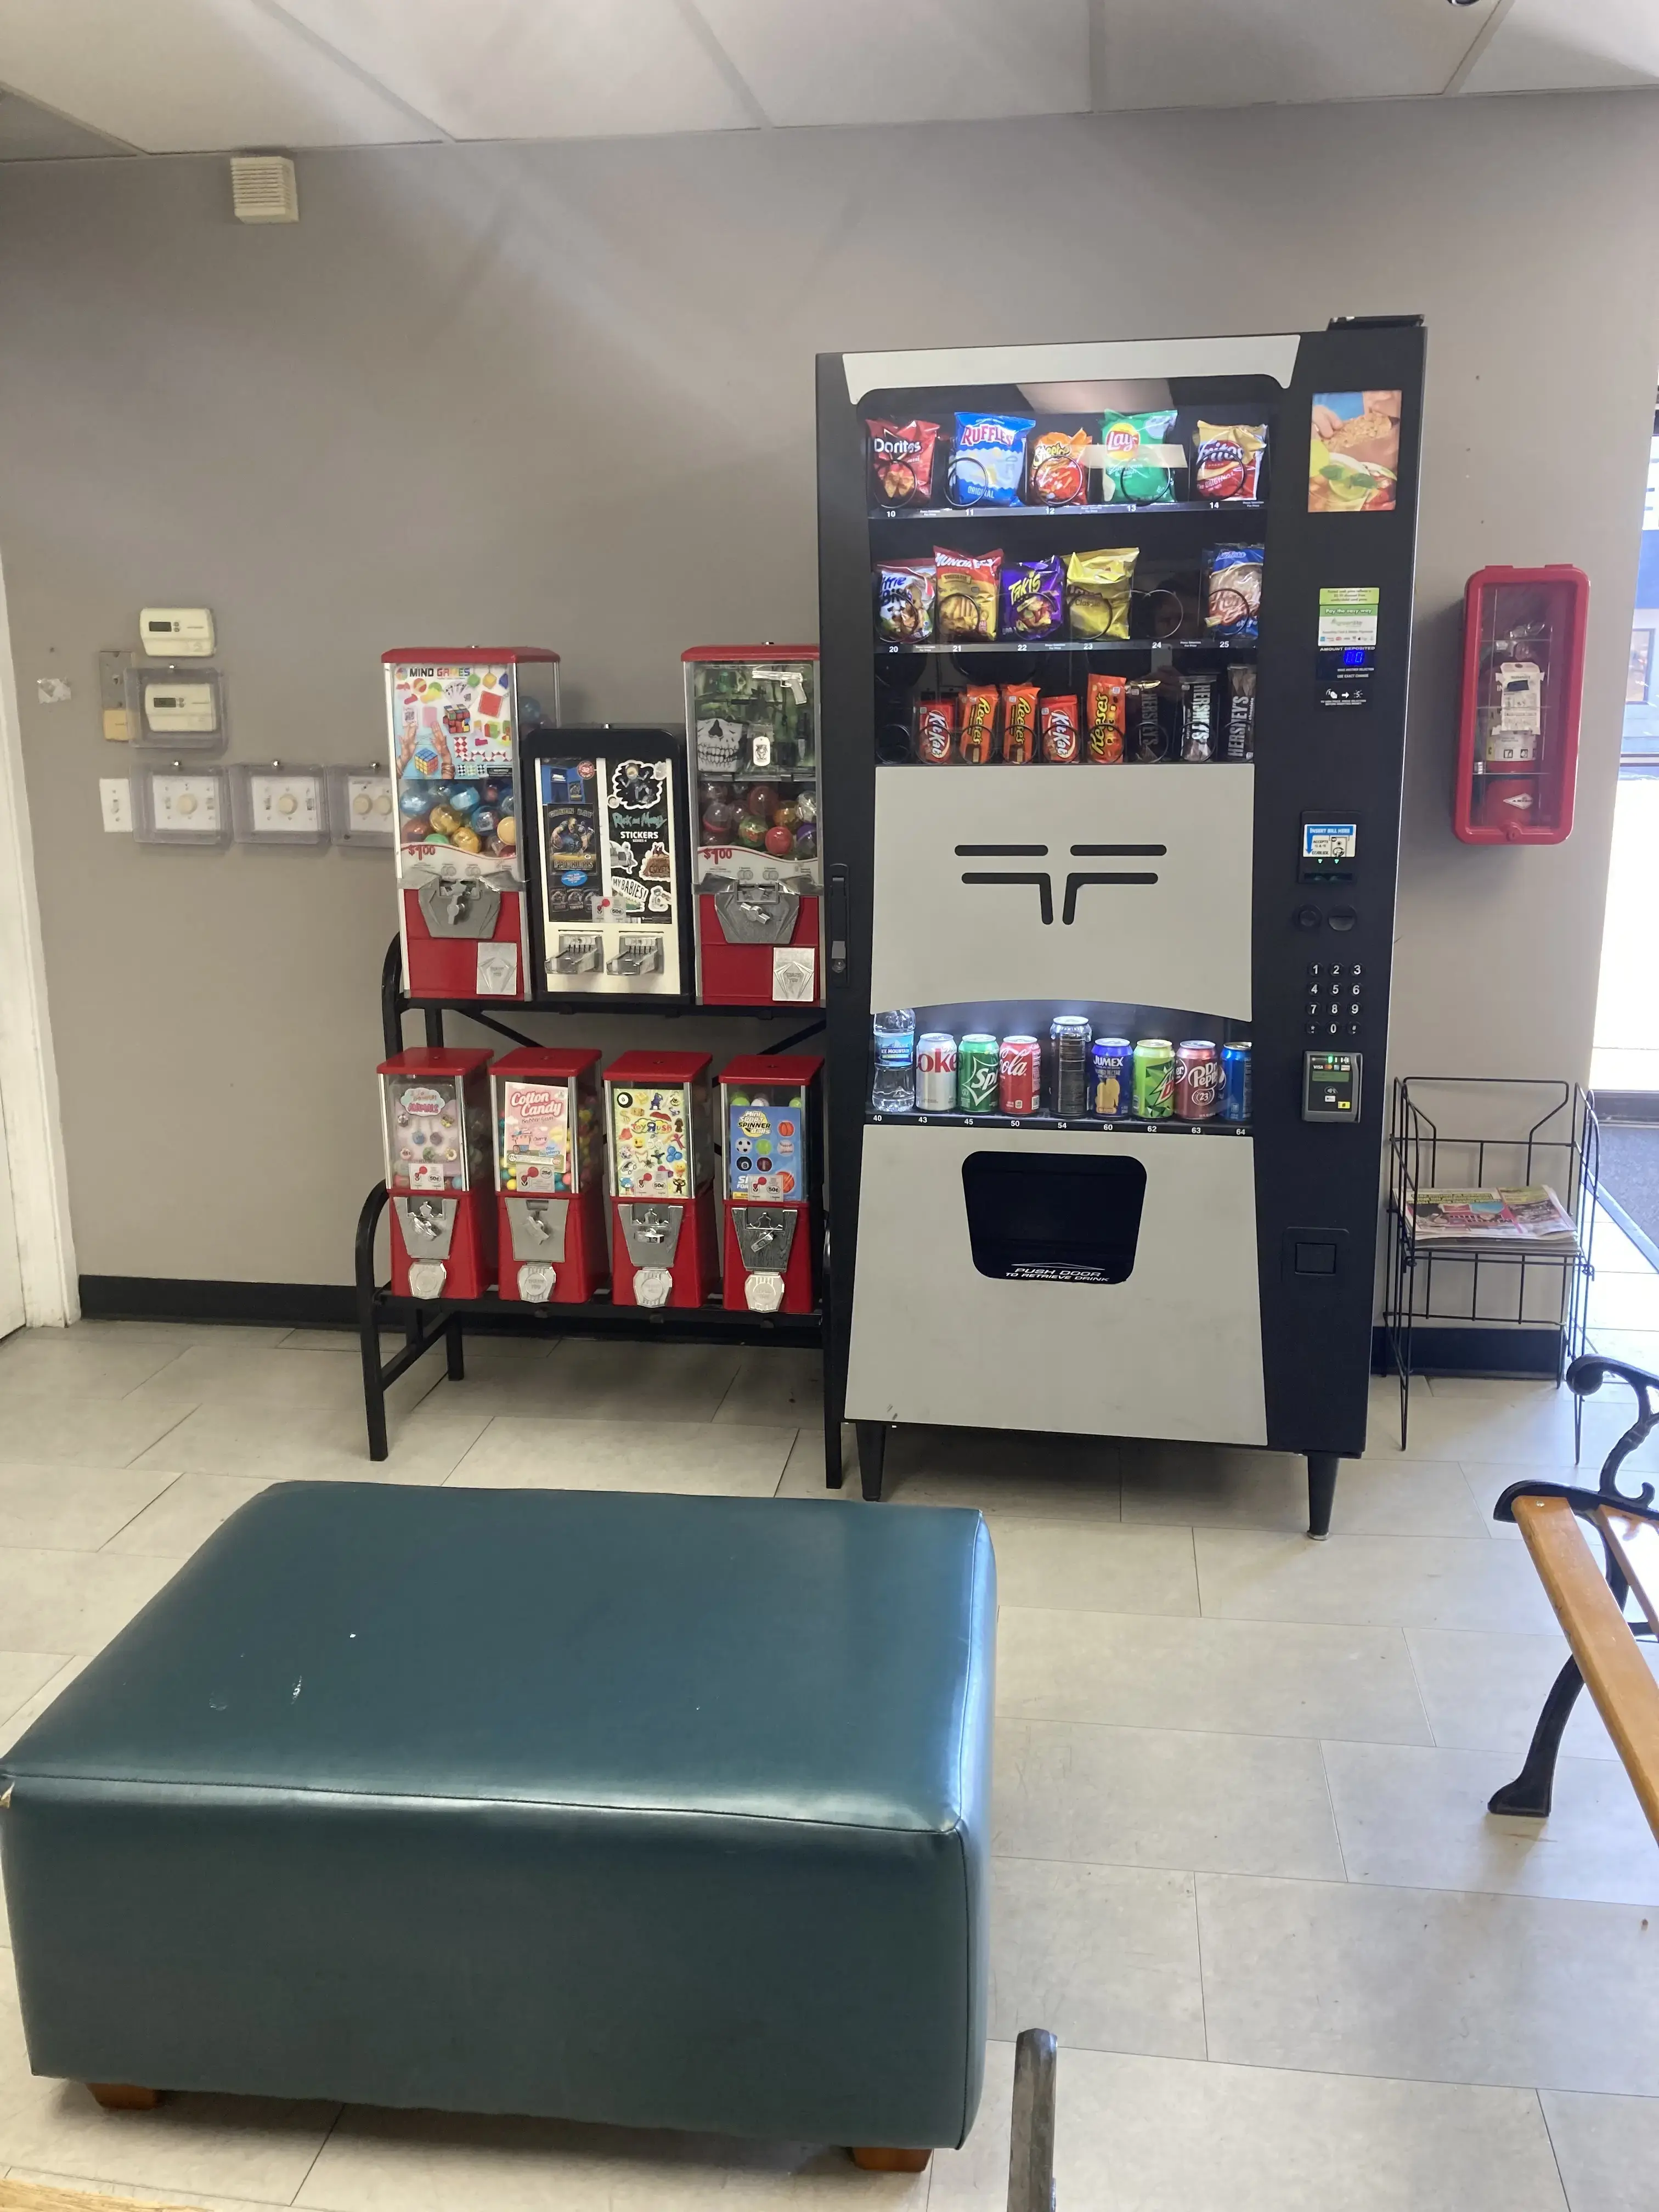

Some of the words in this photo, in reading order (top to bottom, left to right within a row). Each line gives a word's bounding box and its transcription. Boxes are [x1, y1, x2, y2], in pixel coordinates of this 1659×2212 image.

[961, 425, 1015, 446] RUFFLES
[874, 438, 922, 453] Doritos
[1008, 572, 1041, 605] Takis
[409, 668, 434, 677] MIND
[554, 860, 594, 868] PACKERS
[622, 879, 647, 900] BABIES!
[1313, 964, 1318, 974] 1
[1333, 965, 1340, 974] 2
[1354, 964, 1361, 975] 3
[1311, 984, 1318, 994] 4
[1333, 984, 1339, 994] 5
[1353, 985, 1360, 995] 6
[1311, 1005, 1317, 1014] 7
[1331, 1004, 1338, 1014] 8
[1351, 1004, 1359, 1014] 9
[1330, 1024, 1337, 1034] 0
[1093, 1056, 1123, 1066] JUMEX
[1205, 1062, 1217, 1074] Dr
[511, 1091, 549, 1106] Cotton
[1199, 1092, 1209, 1101] 23
[521, 1101, 562, 1117] Candy
